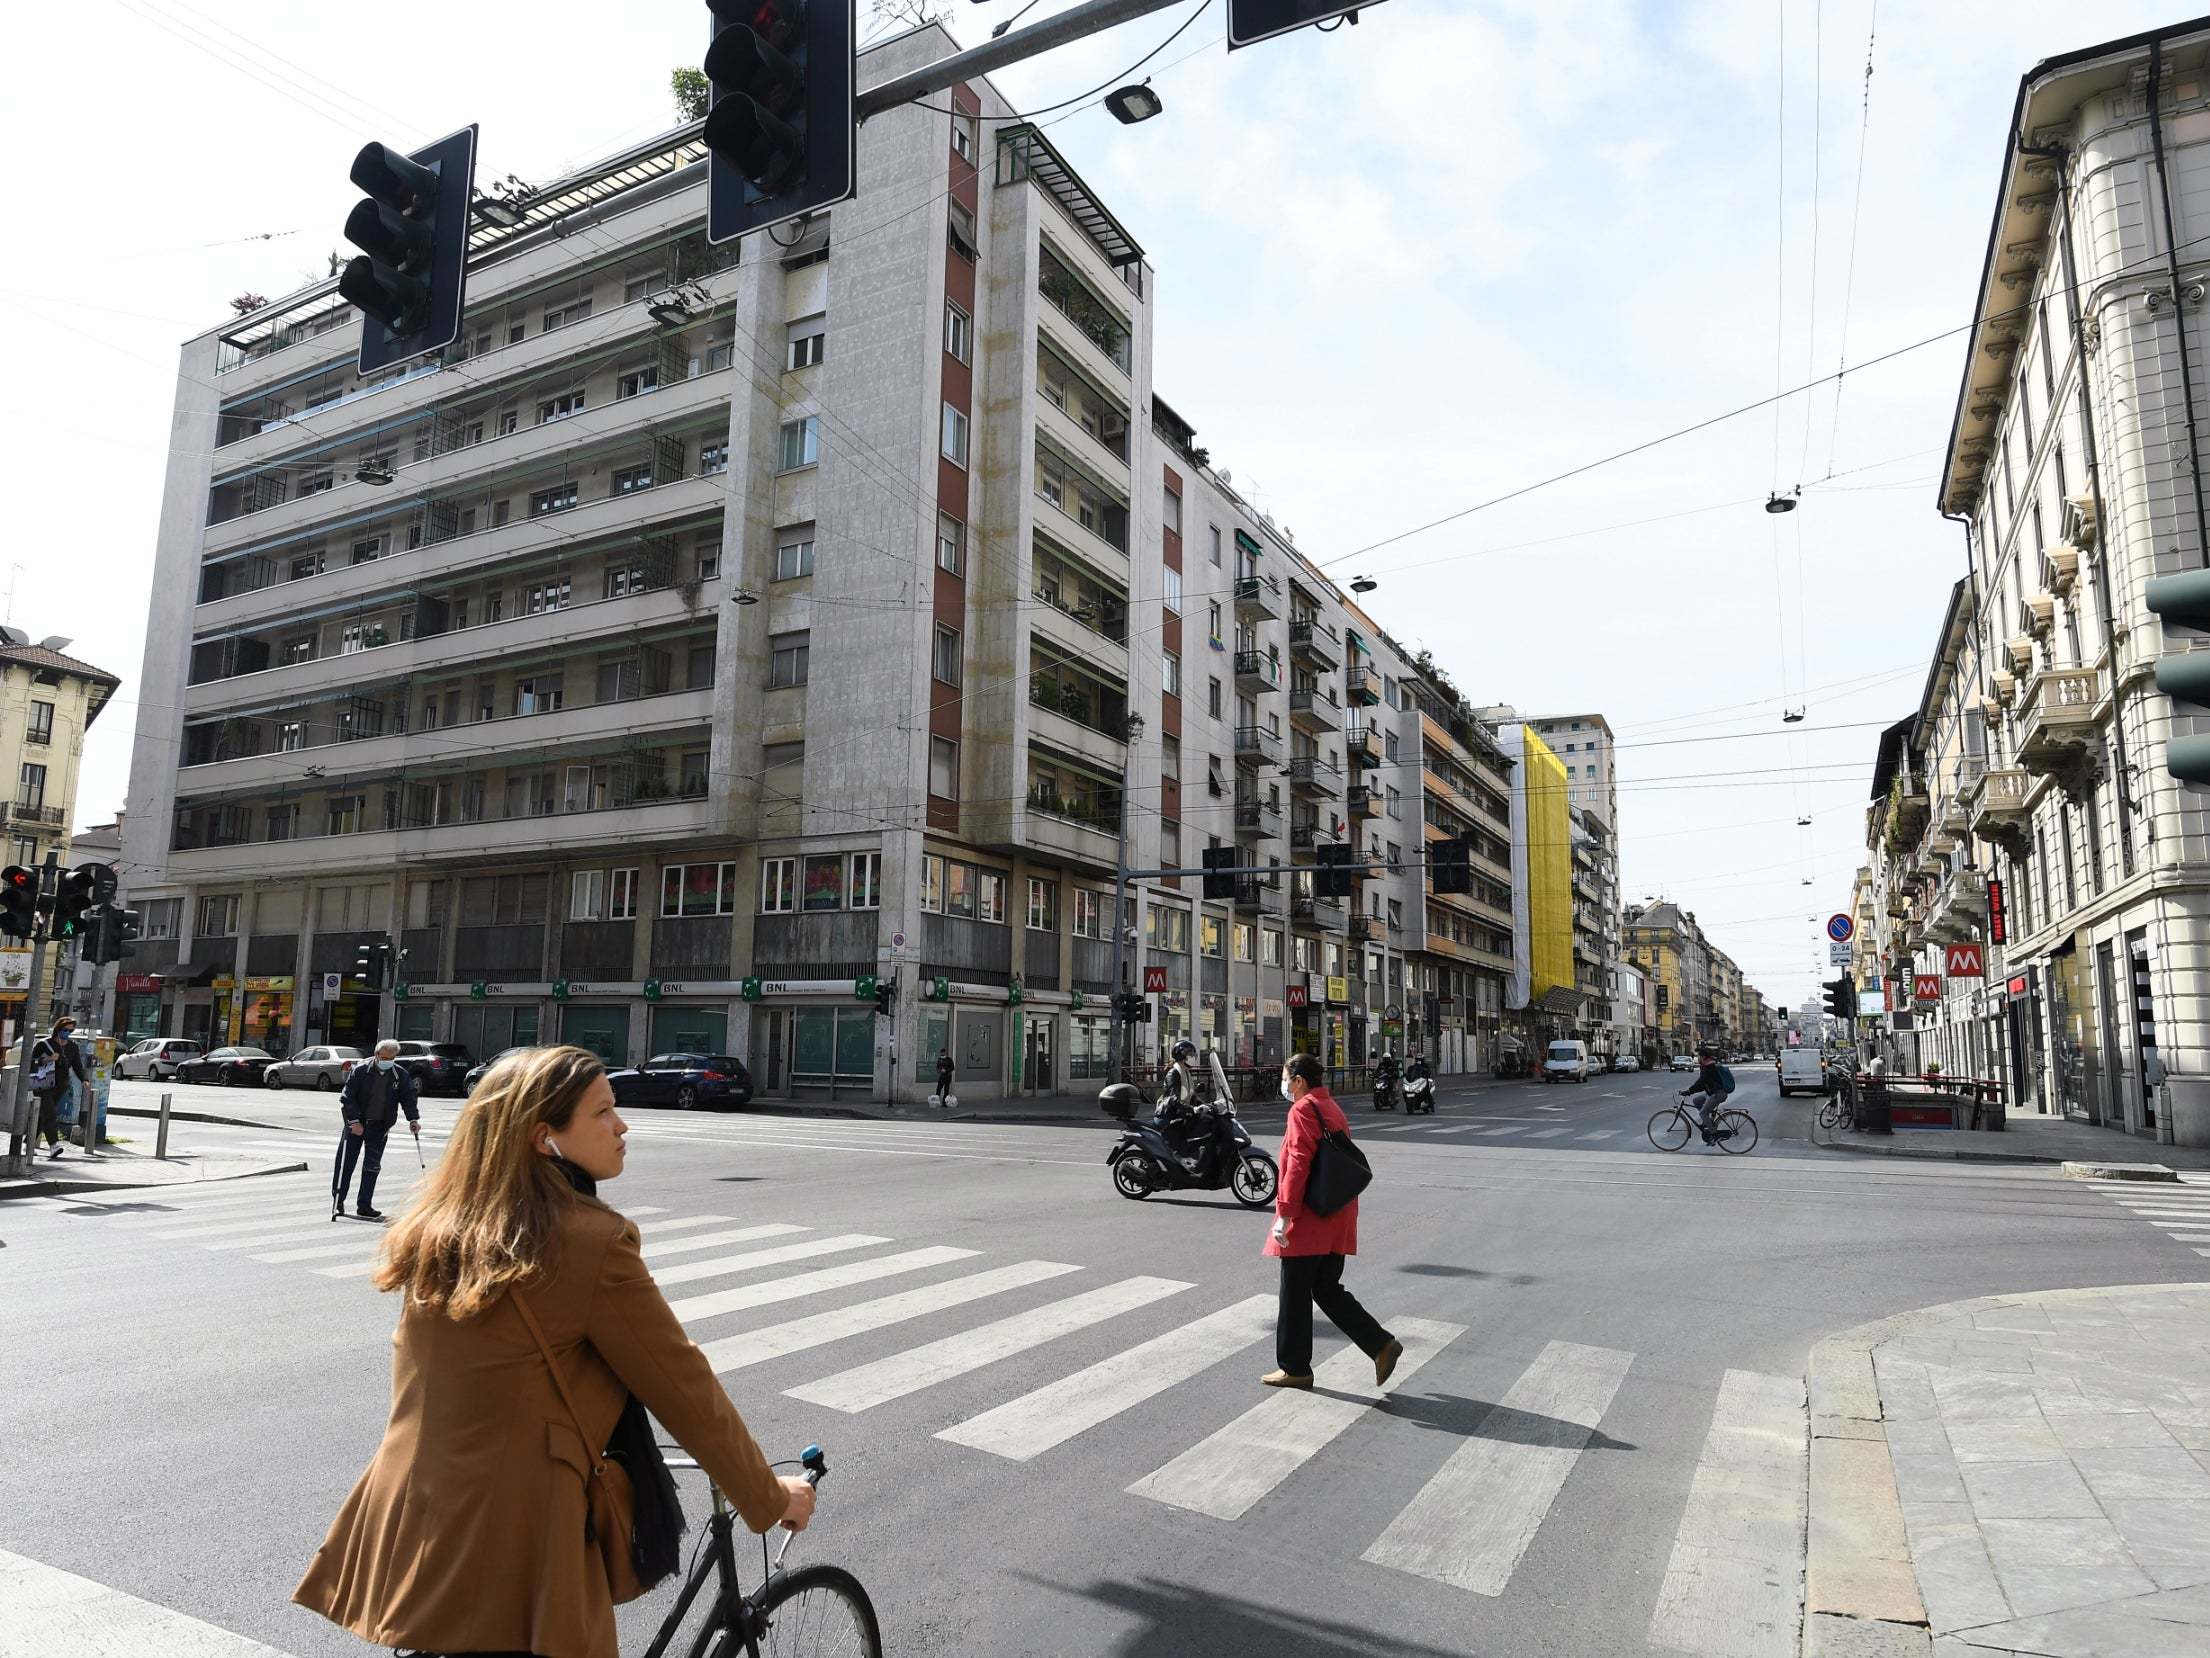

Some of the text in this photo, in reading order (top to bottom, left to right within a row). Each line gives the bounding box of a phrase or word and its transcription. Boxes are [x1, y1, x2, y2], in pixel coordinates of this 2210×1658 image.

[1949, 950, 1981, 971] M
[1146, 973, 1165, 988] M
[410, 986, 427, 994] BNL
[487, 985, 505, 993] BNL
[571, 984, 591, 993] BNL
[663, 984, 685, 993] BNL
[766, 983, 789, 992] BNL
[950, 985, 967, 995] BNL
[1916, 980, 1939, 995] M
[1289, 991, 1304, 1002] M
